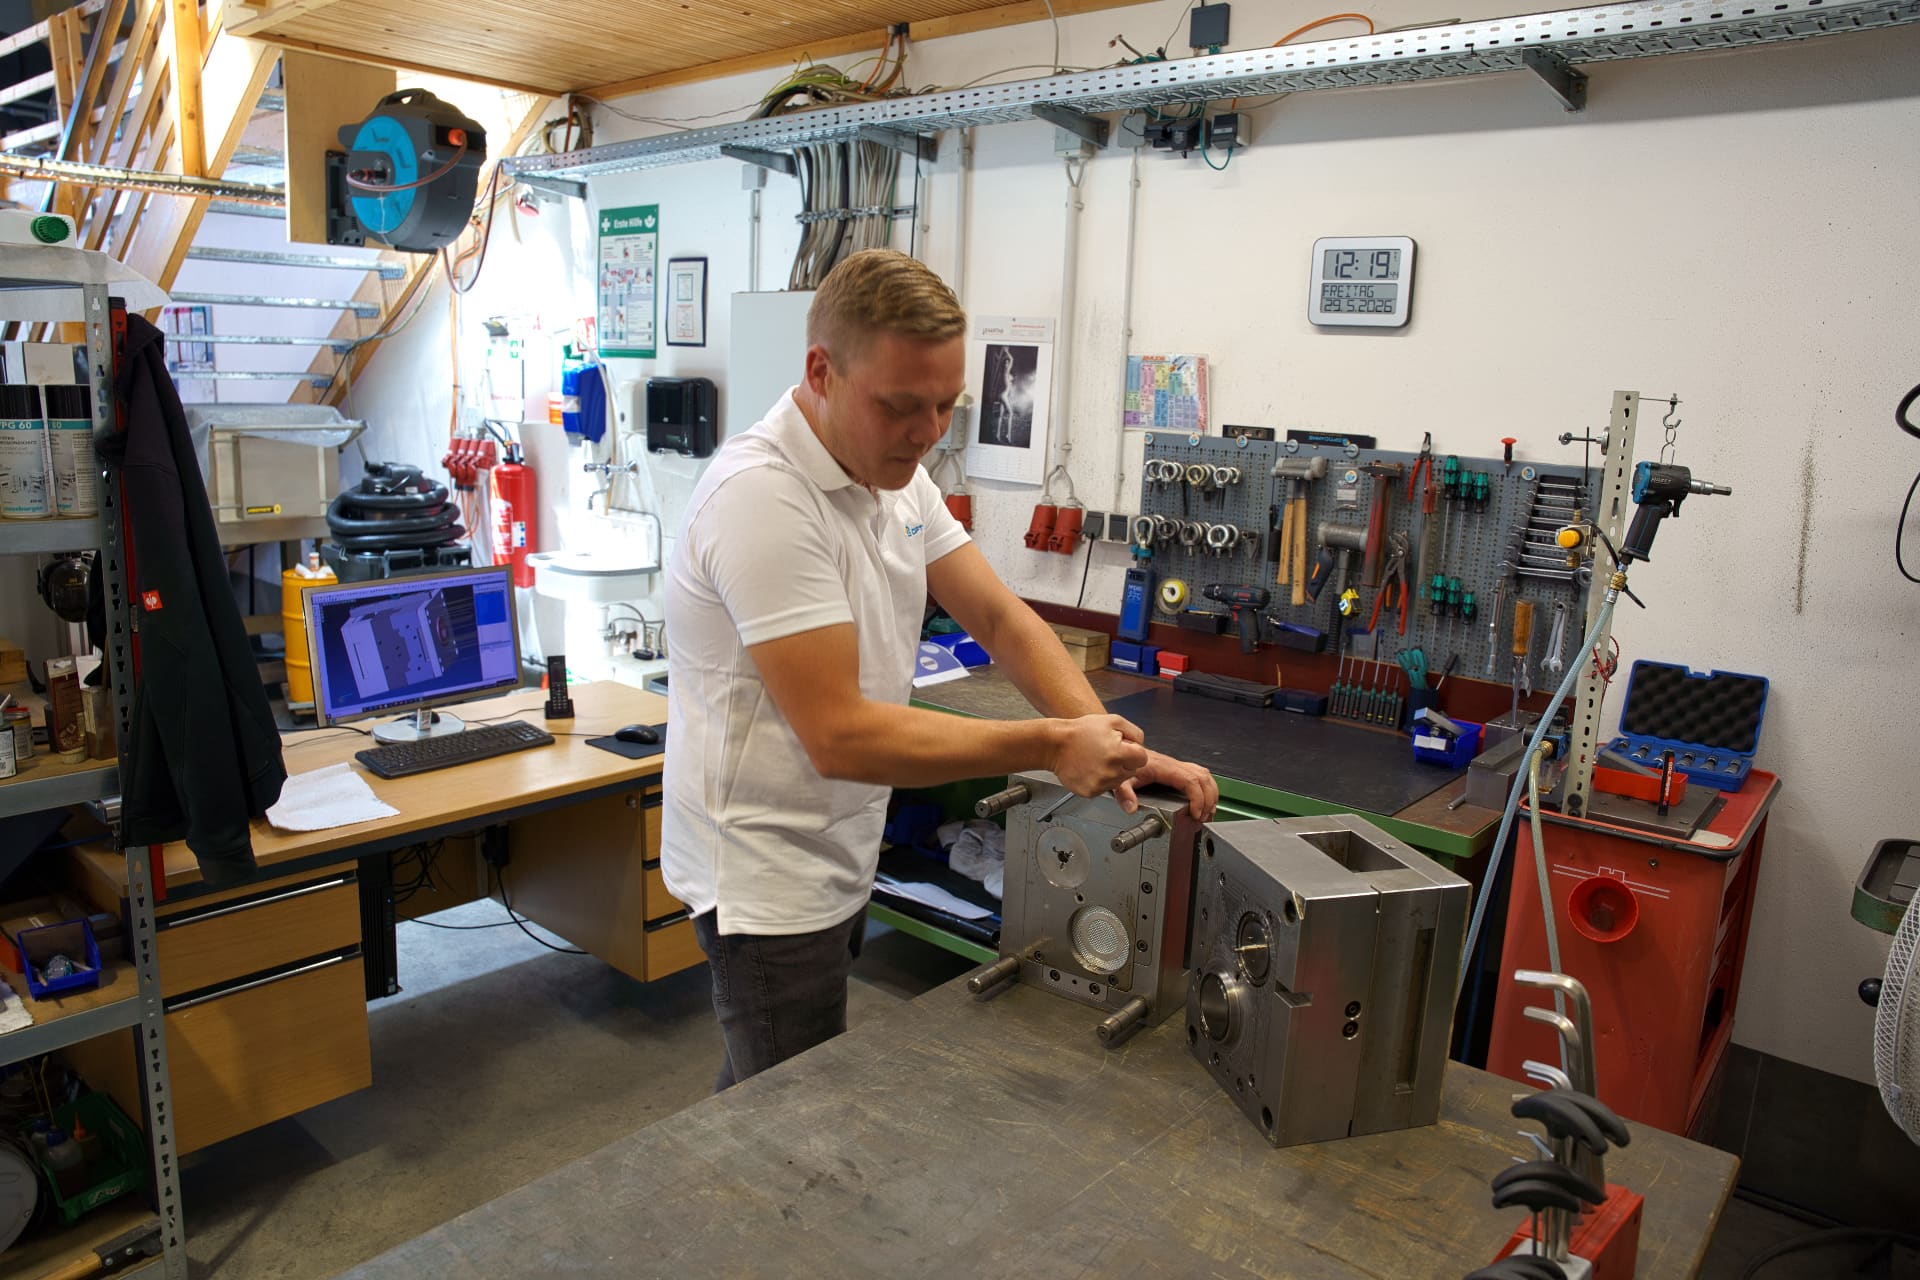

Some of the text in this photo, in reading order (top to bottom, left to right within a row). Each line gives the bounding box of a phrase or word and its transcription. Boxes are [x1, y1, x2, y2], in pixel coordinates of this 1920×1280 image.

[614, 217, 643, 229] Erste Hilfe
[1335, 252, 1390, 278] 12:19
[1323, 285, 1375, 298] FREITAG
[0, 421, 32, 430] PG 60
